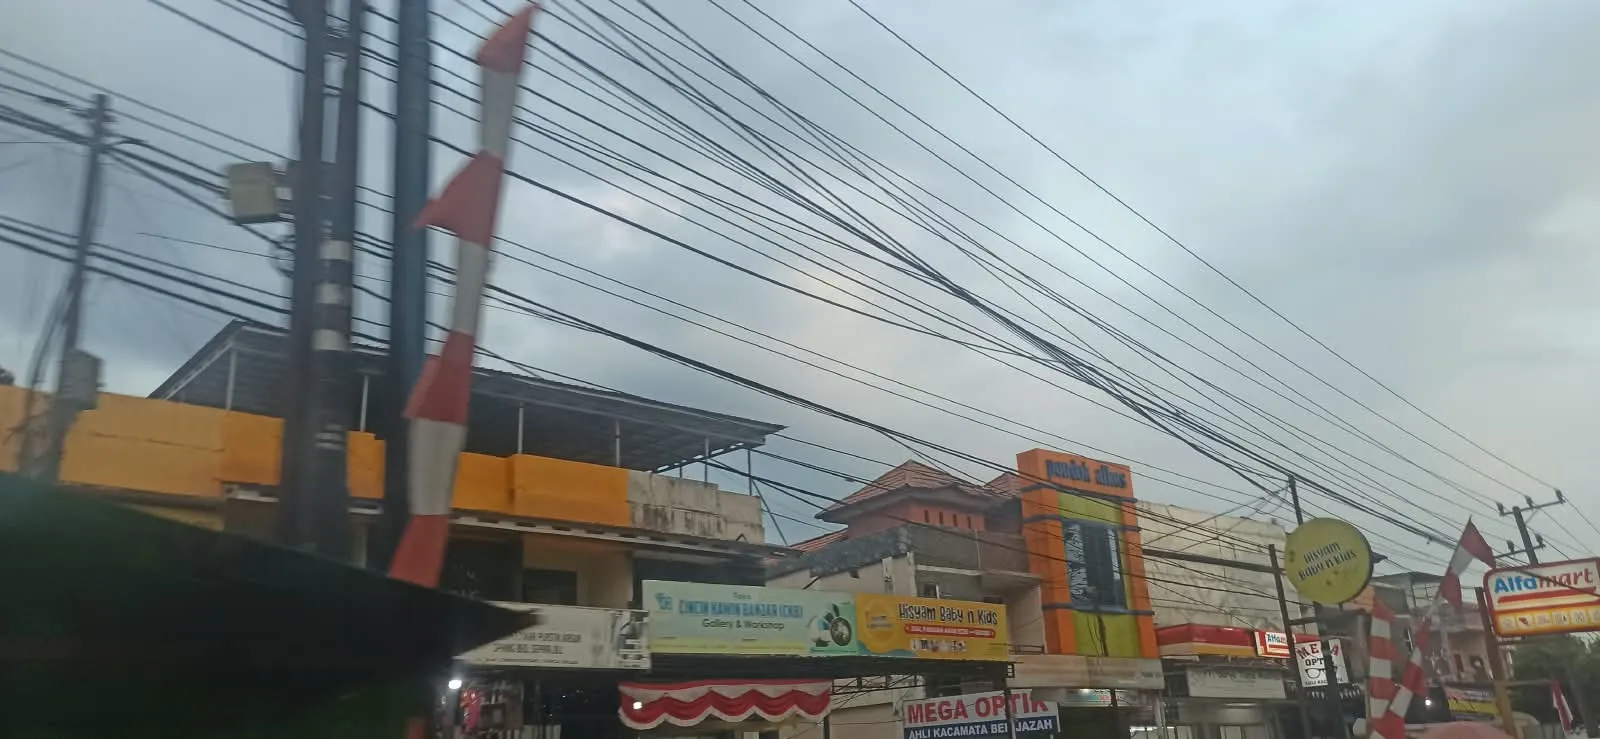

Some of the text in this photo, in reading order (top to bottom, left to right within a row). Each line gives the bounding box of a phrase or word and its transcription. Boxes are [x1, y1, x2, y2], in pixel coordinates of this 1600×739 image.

[1494, 568, 1594, 593] Alfamart
[702, 619, 784, 631] Gallery & Workshop
[899, 604, 998, 625] Hisyam Baby n Kids
[907, 699, 968, 724] MEGA
[908, 729, 931, 739] AHLI
[933, 723, 988, 738] KACAMATA
